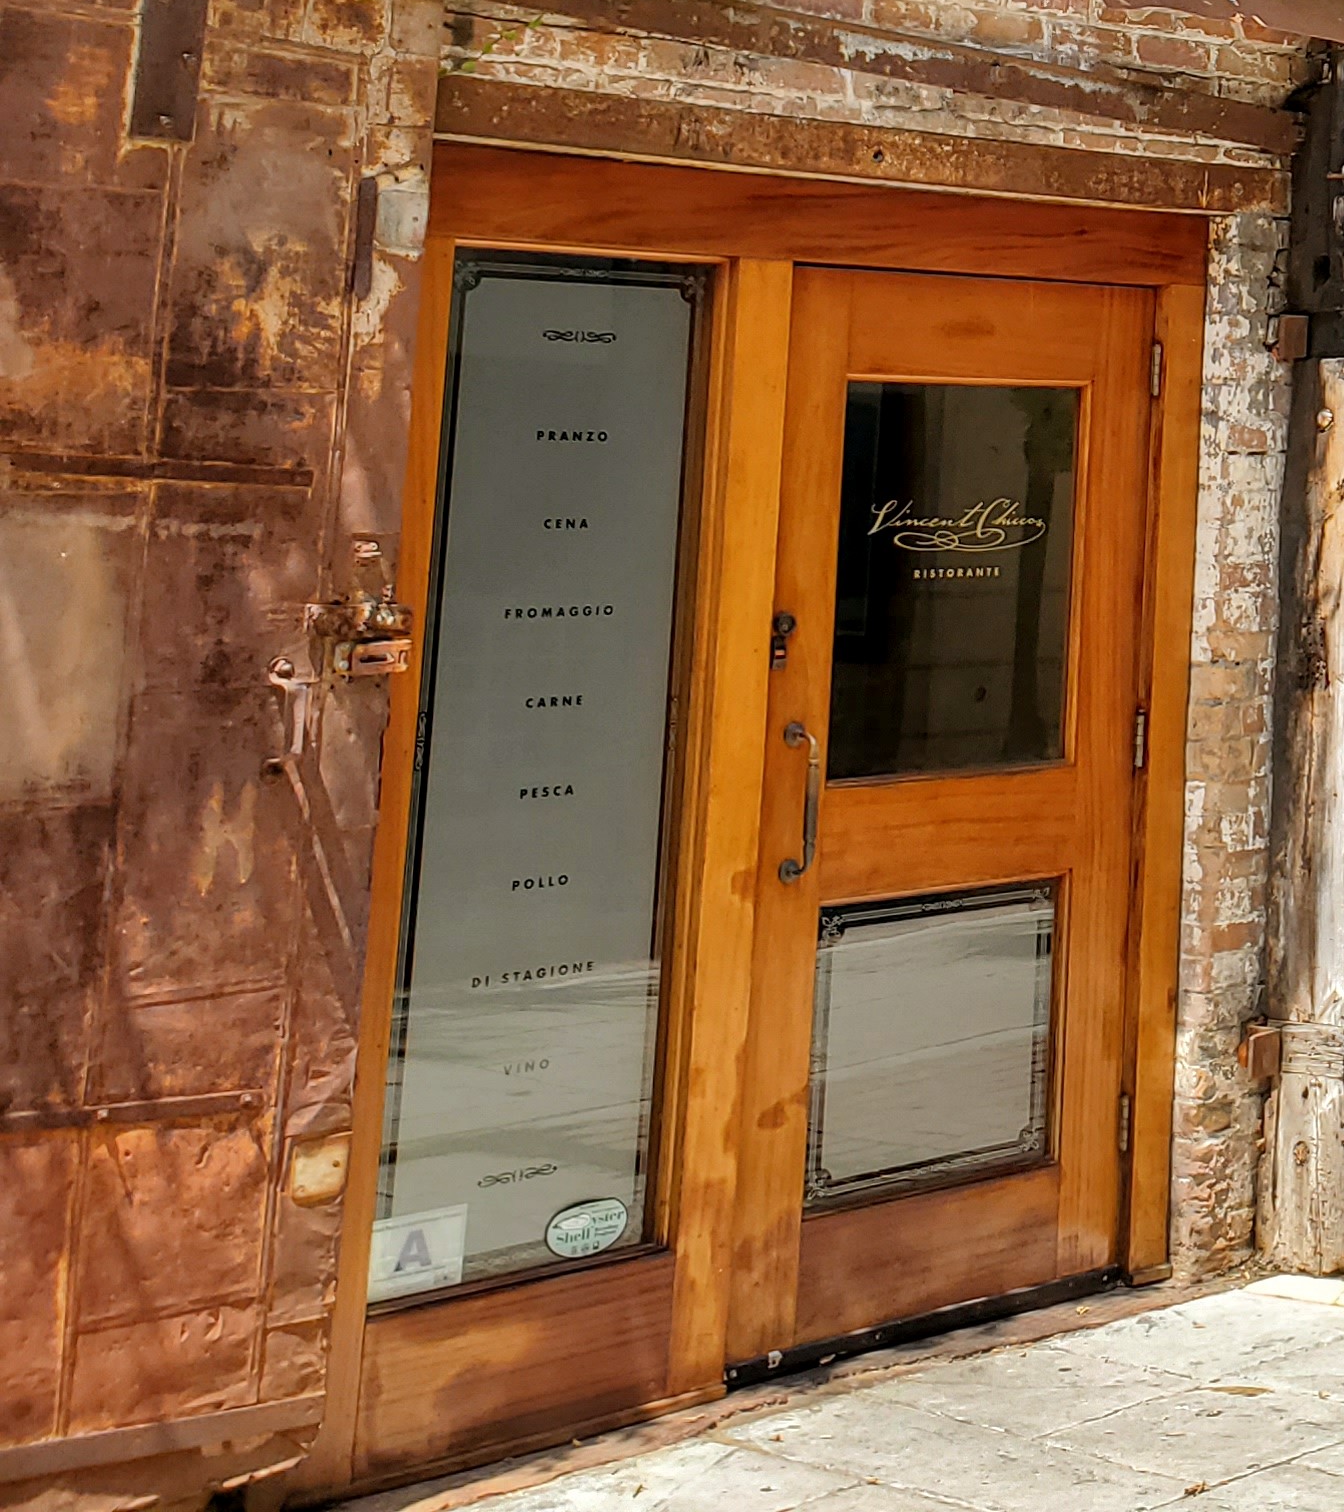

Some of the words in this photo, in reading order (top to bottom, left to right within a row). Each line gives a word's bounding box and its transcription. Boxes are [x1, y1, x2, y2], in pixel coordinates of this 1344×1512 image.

[536, 429, 609, 443] PRANZO
[543, 518, 590, 530] CENA
[866, 499, 986, 536] Vincent
[913, 566, 1000, 580] RISTORANTE
[505, 604, 615, 619] FROMAGGIO
[525, 694, 585, 709] CARNE
[519, 784, 576, 800] PESCA
[511, 874, 571, 892] POLLO
[472, 975, 491, 989] DI
[501, 960, 596, 985] STAGIONE
[503, 1058, 551, 1077] VINO
[394, 1229, 431, 1272] A
